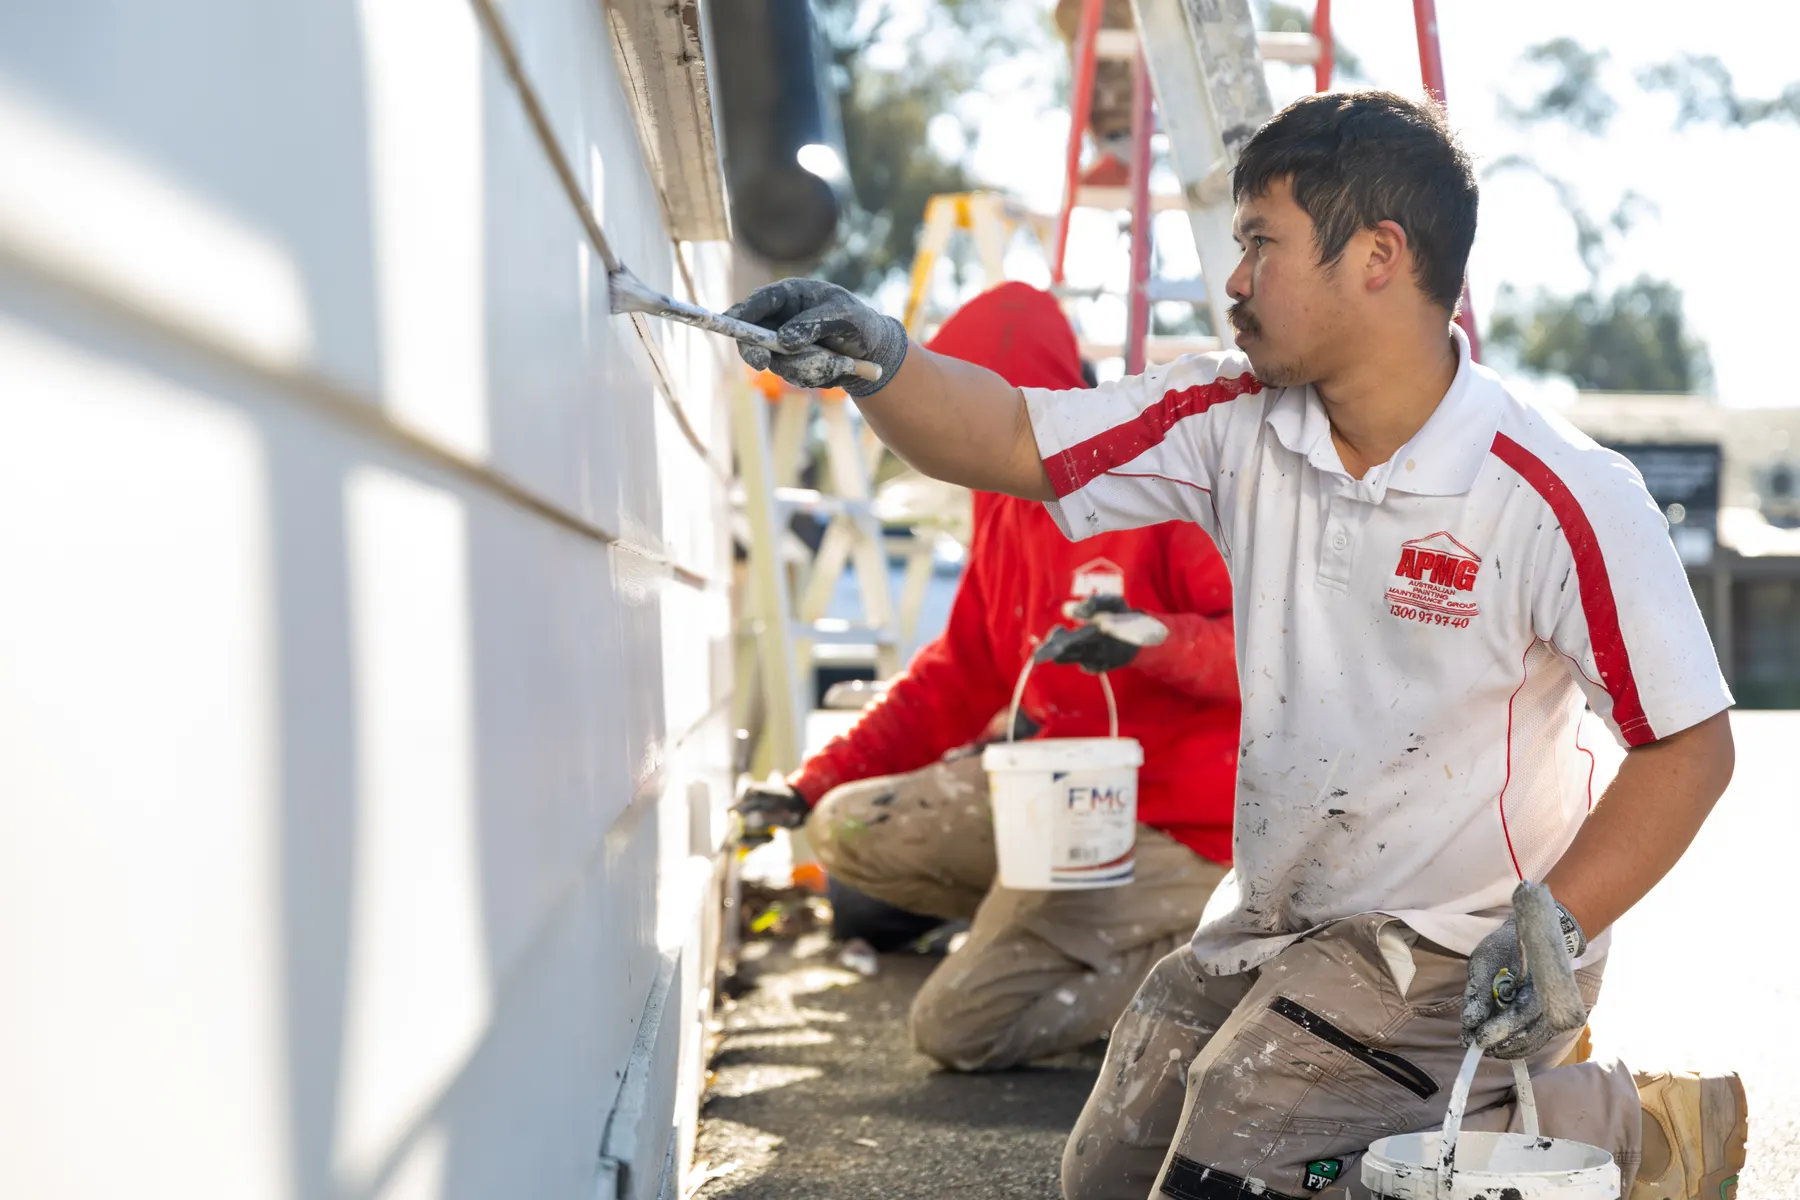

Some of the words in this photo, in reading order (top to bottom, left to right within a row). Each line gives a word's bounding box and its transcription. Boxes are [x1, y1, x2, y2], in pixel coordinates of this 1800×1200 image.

[1395, 548, 1480, 592] APMG
[1408, 580, 1456, 596] AUSTRALIAN
[1413, 587, 1449, 600] PAINTING
[1389, 587, 1443, 605] MAINTENANCE
[1447, 601, 1477, 609] GROUP
[1390, 604, 1416, 620] 1300
